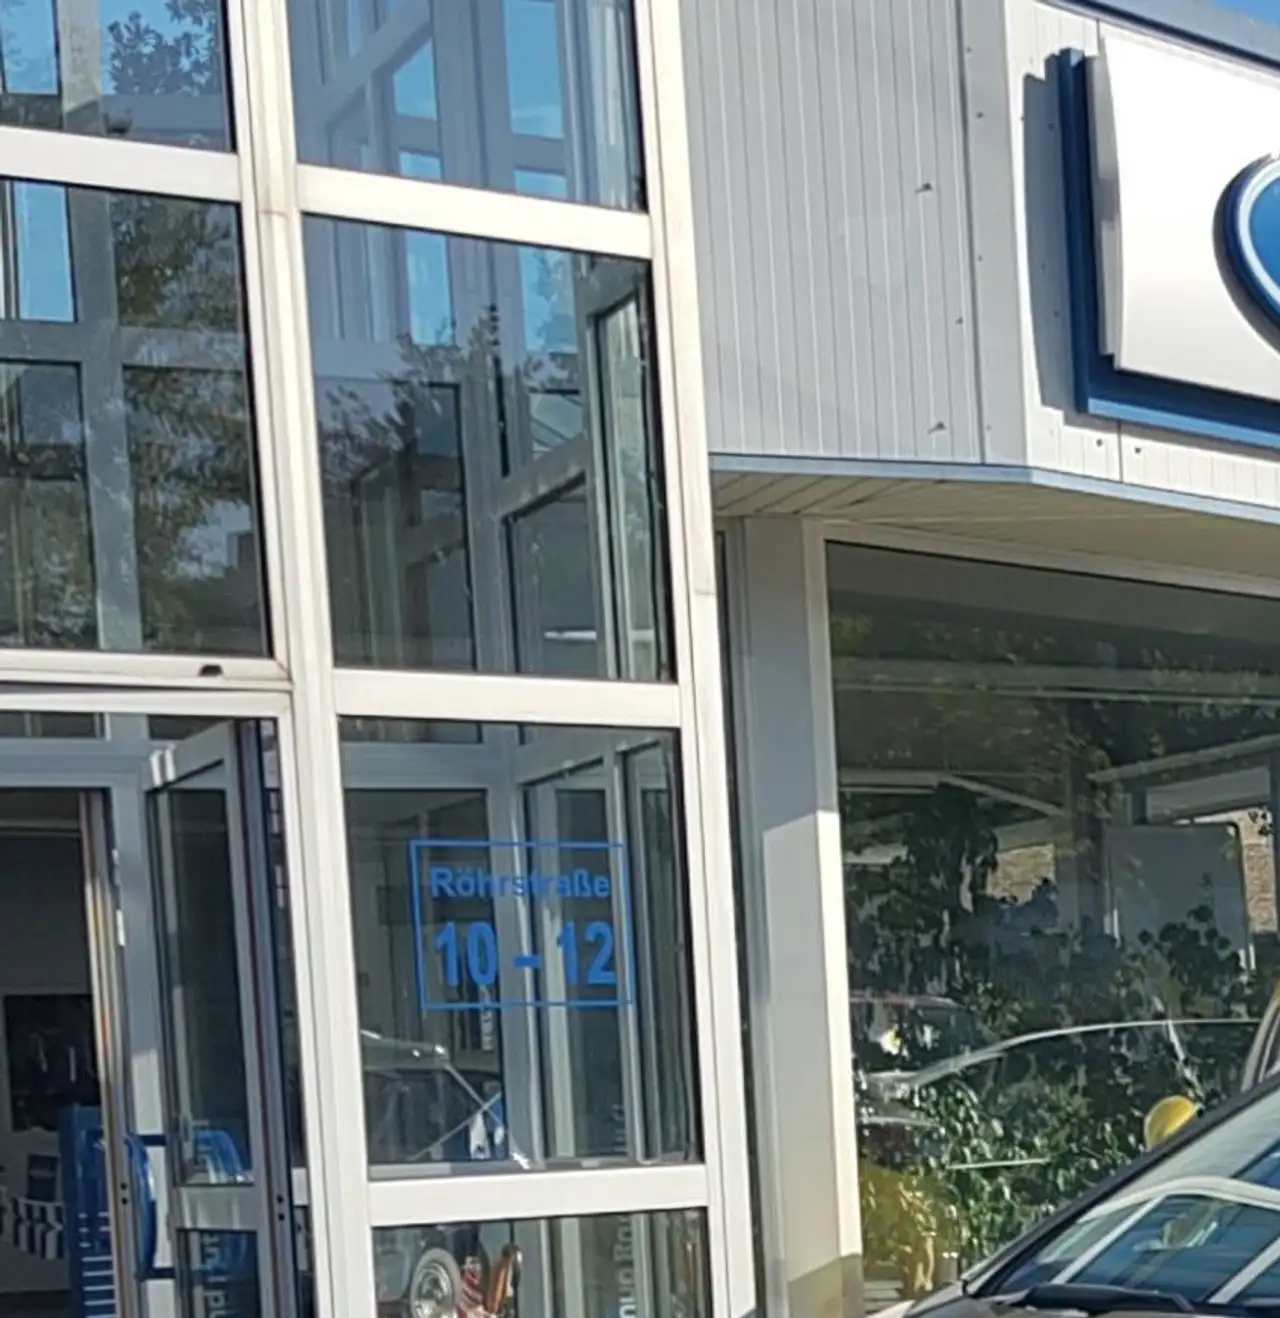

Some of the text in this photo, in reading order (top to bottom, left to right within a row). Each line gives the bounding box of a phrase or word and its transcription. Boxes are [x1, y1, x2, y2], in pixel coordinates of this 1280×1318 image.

[430, 866, 610, 898] Röhrstraße
[434, 921, 497, 988] 10
[556, 921, 618, 985] 12
